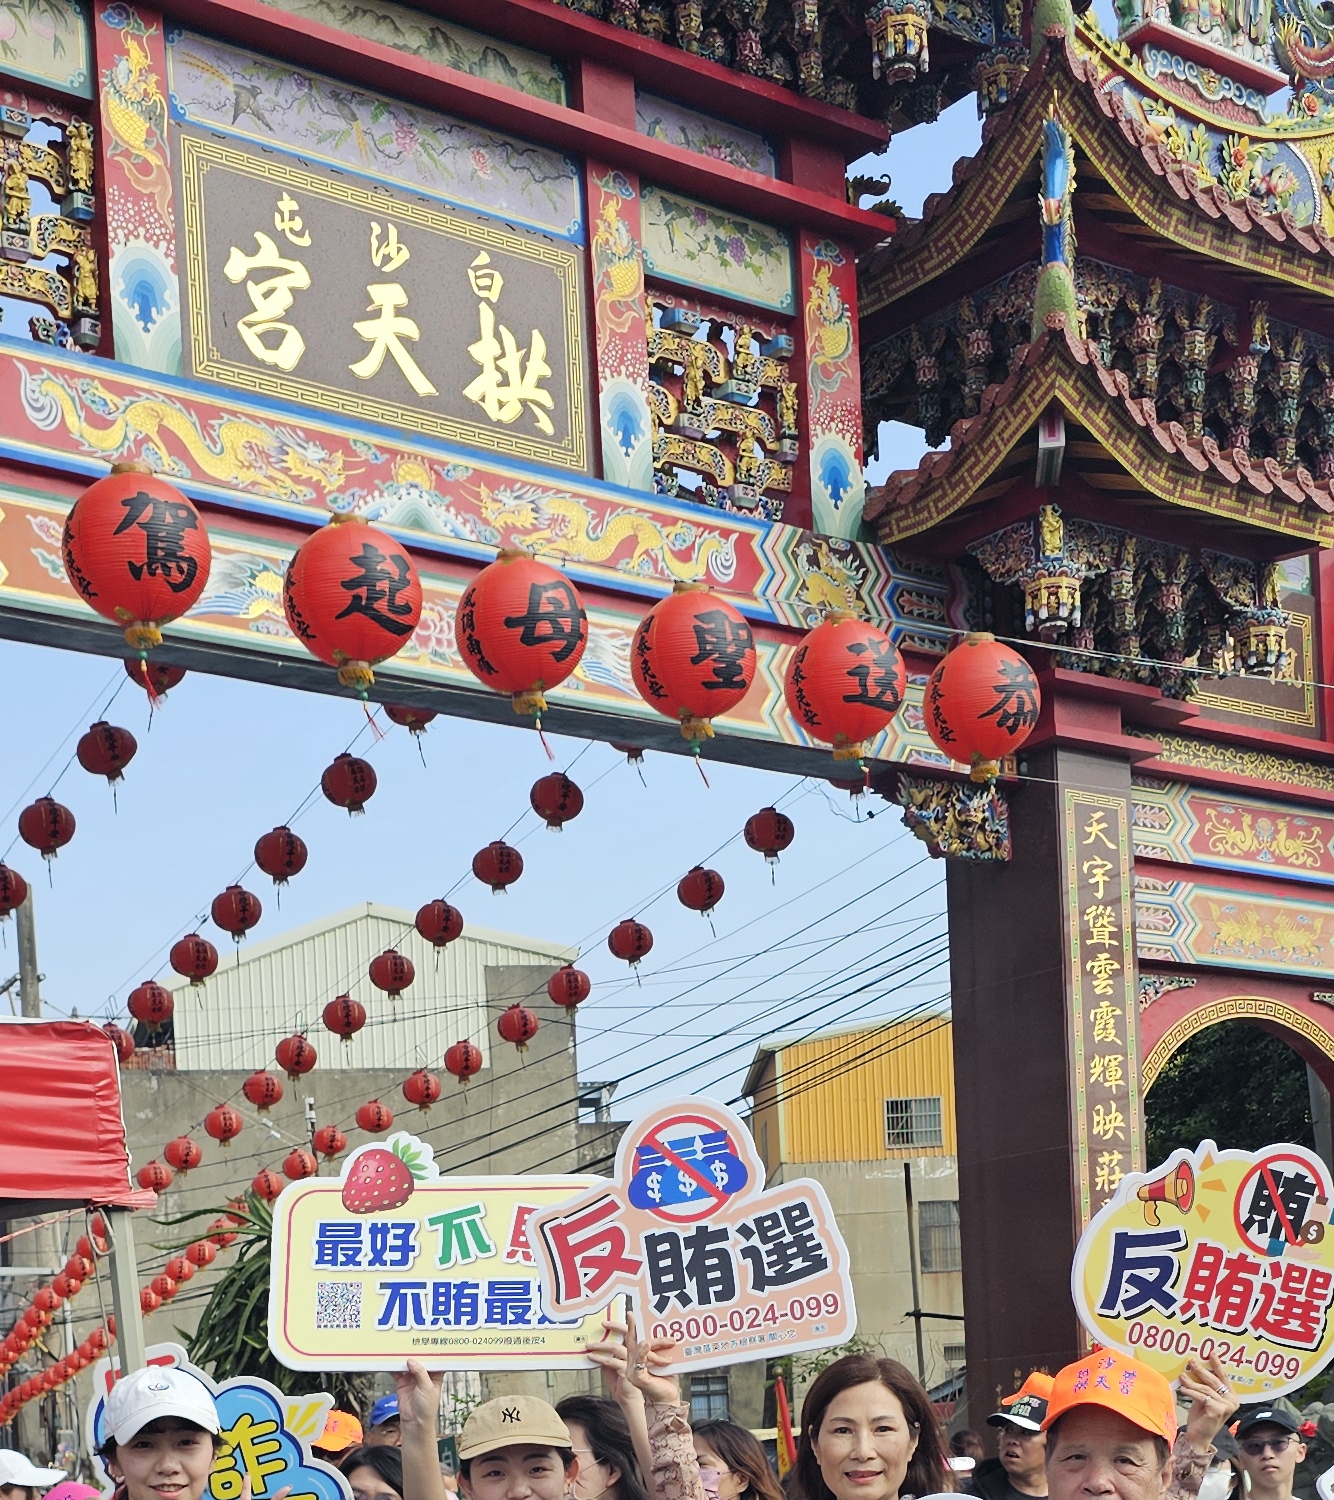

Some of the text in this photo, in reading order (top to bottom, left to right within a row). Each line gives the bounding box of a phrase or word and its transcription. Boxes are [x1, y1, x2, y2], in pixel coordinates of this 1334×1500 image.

[112, 491, 199, 593] 駕
[334, 542, 413, 636] 起
[504, 580, 589, 663] 母
[689, 608, 753, 690] 聖
[842, 638, 902, 713] 送
[977, 659, 1040, 735] 恭
[1080, 810, 1129, 1207] 天宇聳雲霞輝映莊
[551, 1199, 830, 1316] 反賄選
[1098, 1229, 1334, 1345] 反賄選
[652, 1293, 840, 1343] 0800-024-099
[1128, 1320, 1301, 1381] 0800-024-099
